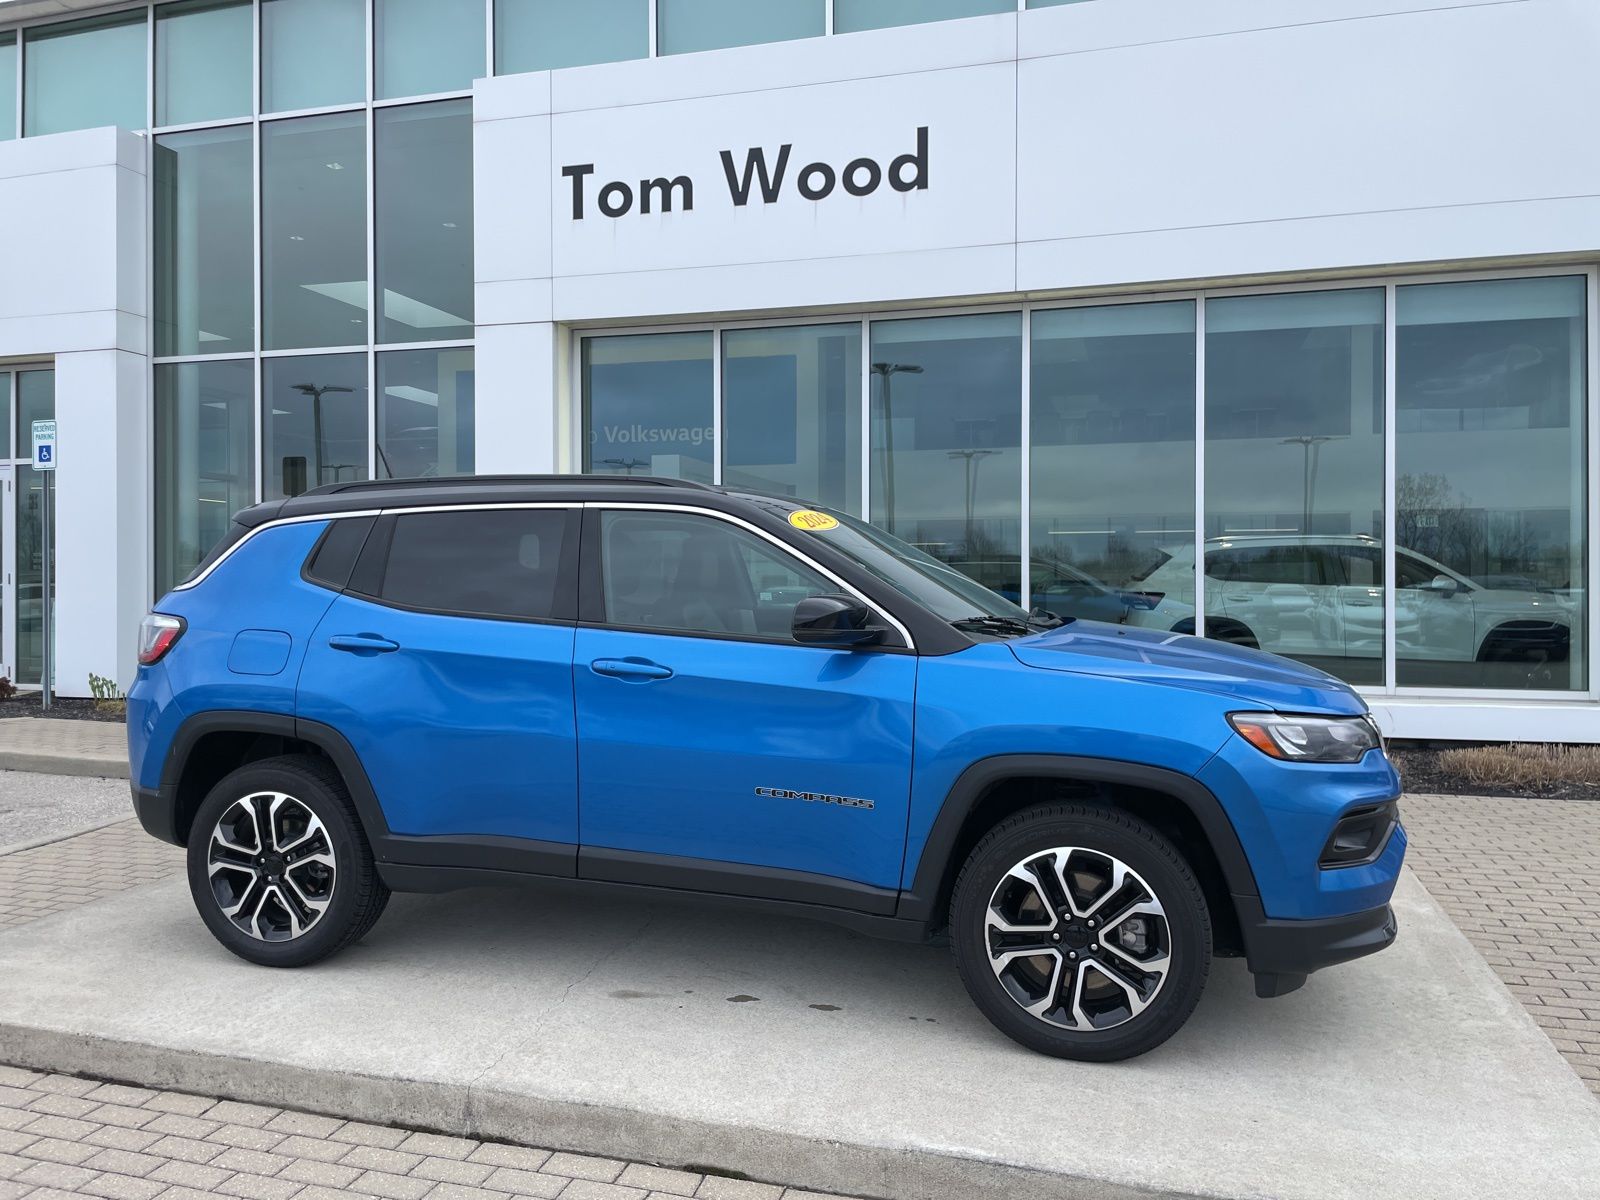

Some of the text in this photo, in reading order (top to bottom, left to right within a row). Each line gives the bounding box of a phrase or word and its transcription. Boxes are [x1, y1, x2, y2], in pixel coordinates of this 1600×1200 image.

[562, 126, 929, 220] Tom Wood
[33, 425, 55, 433] RESERVED
[35, 433, 54, 441] PARKING
[797, 514, 832, 528] 2024
[755, 787, 874, 809] COMPASS
